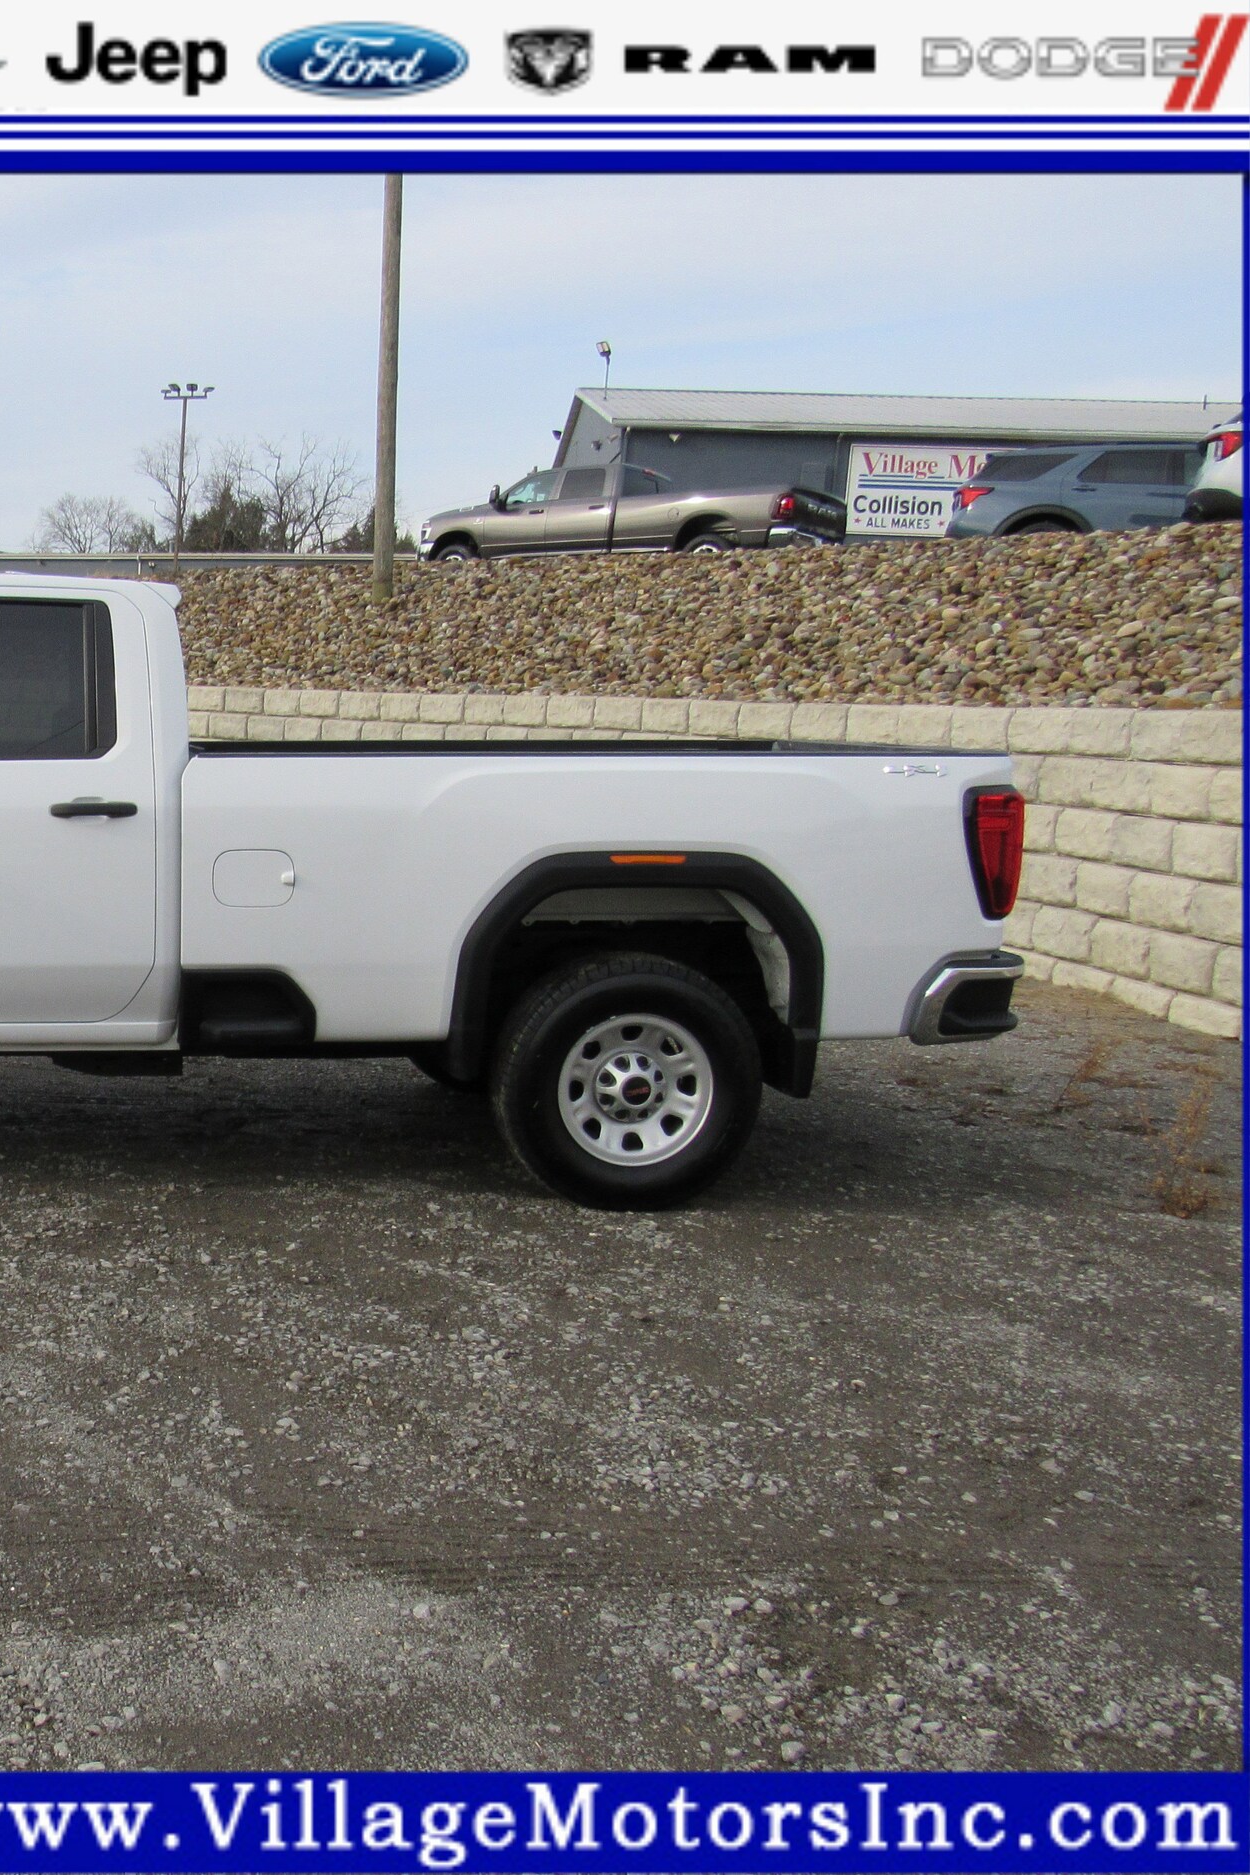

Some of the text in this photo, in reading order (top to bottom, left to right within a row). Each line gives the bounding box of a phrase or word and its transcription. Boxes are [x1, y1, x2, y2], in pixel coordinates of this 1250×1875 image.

[862, 451, 939, 480] Village
[853, 494, 943, 516] Collision
[866, 517, 931, 530] ALL MAKES
